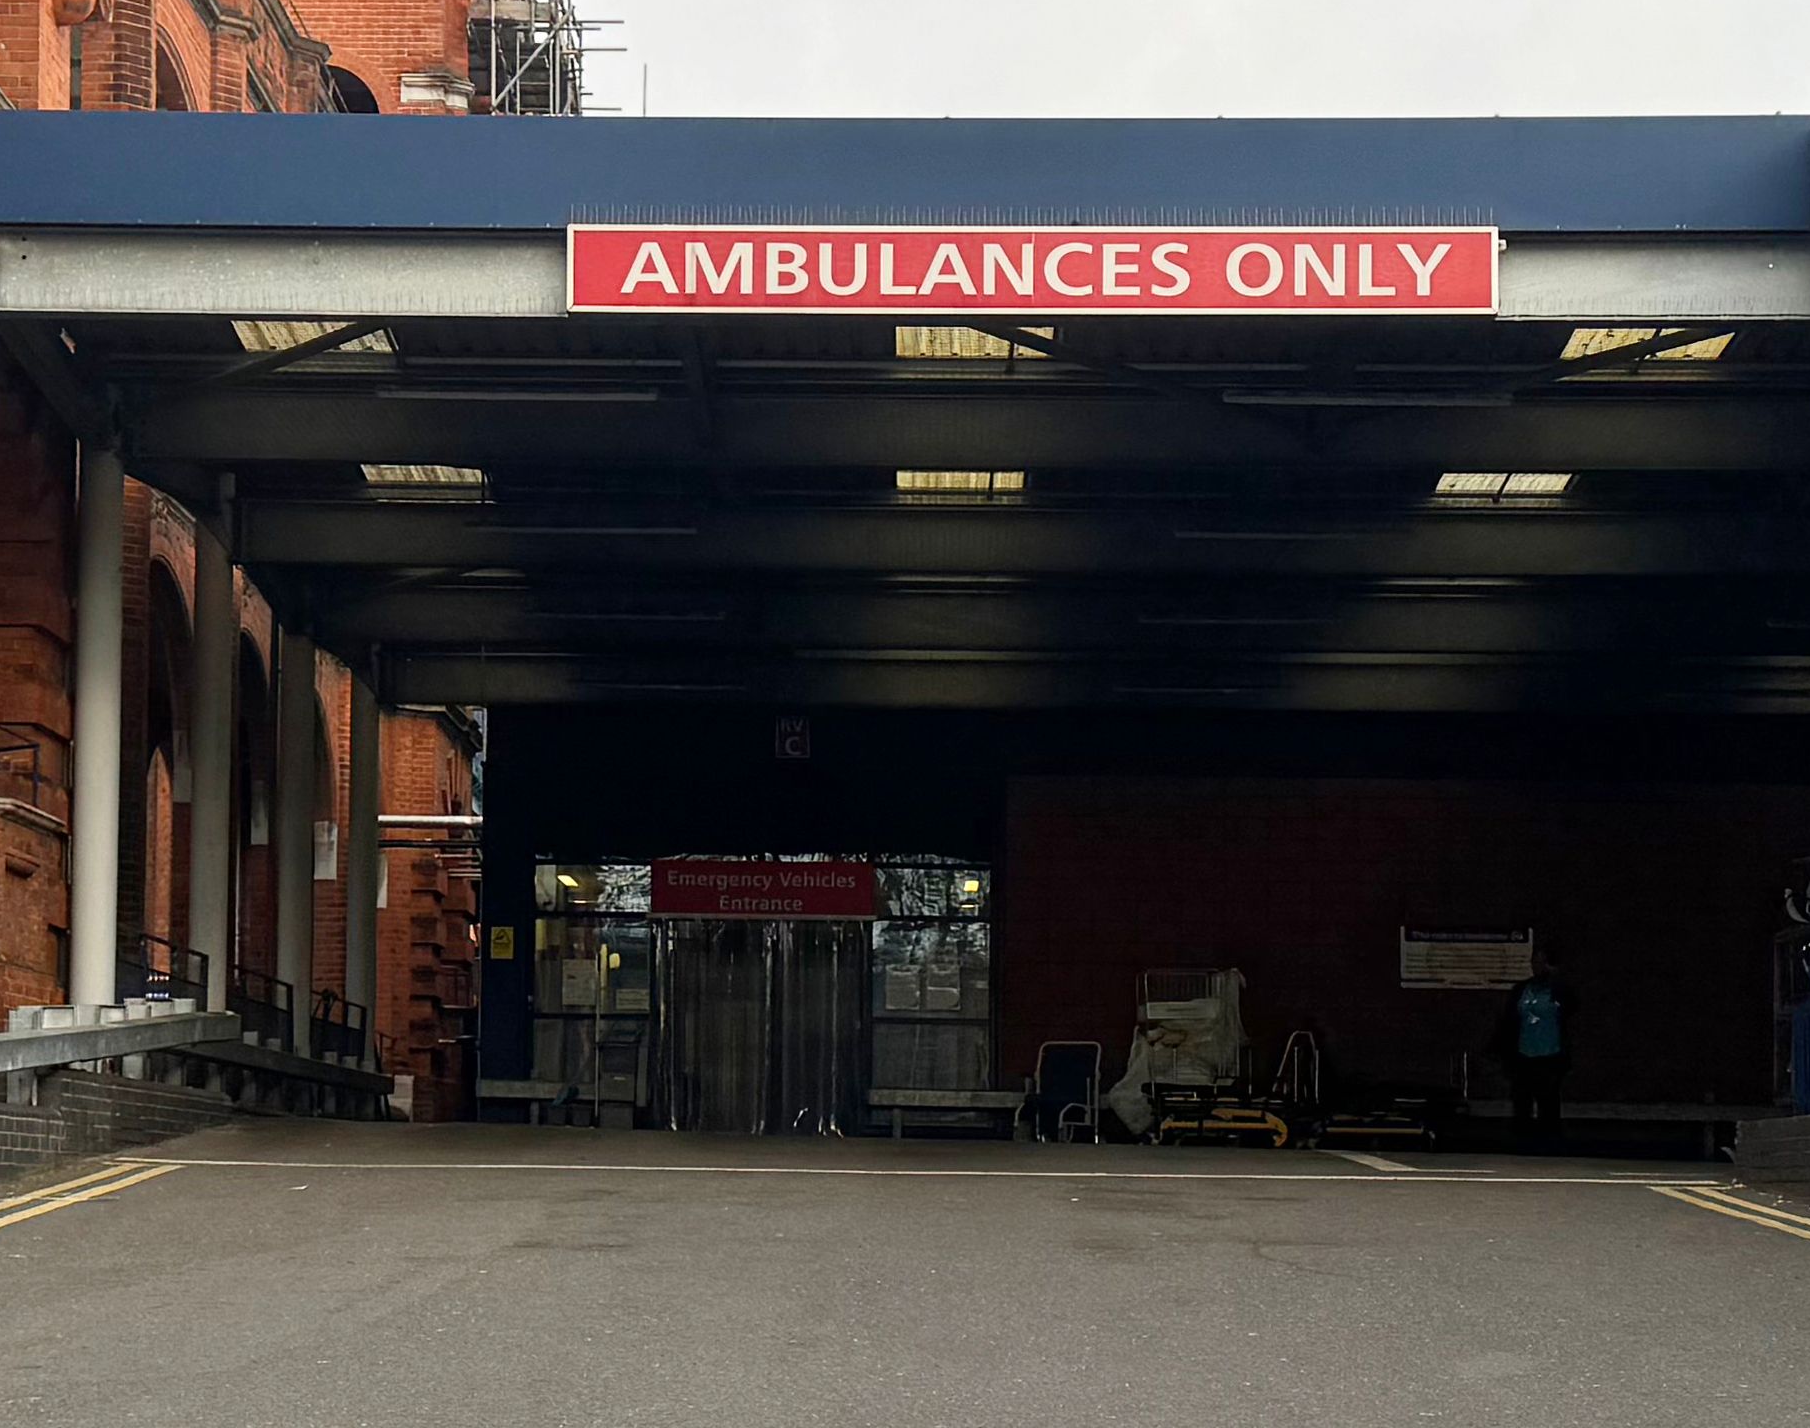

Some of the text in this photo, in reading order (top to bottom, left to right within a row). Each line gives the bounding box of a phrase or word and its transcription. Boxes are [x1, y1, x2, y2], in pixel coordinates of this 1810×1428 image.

[620, 241, 1452, 297] AMBULANCES ONLY
[666, 869, 856, 891] Emergency Vehicles
[718, 895, 804, 911] Entrance
